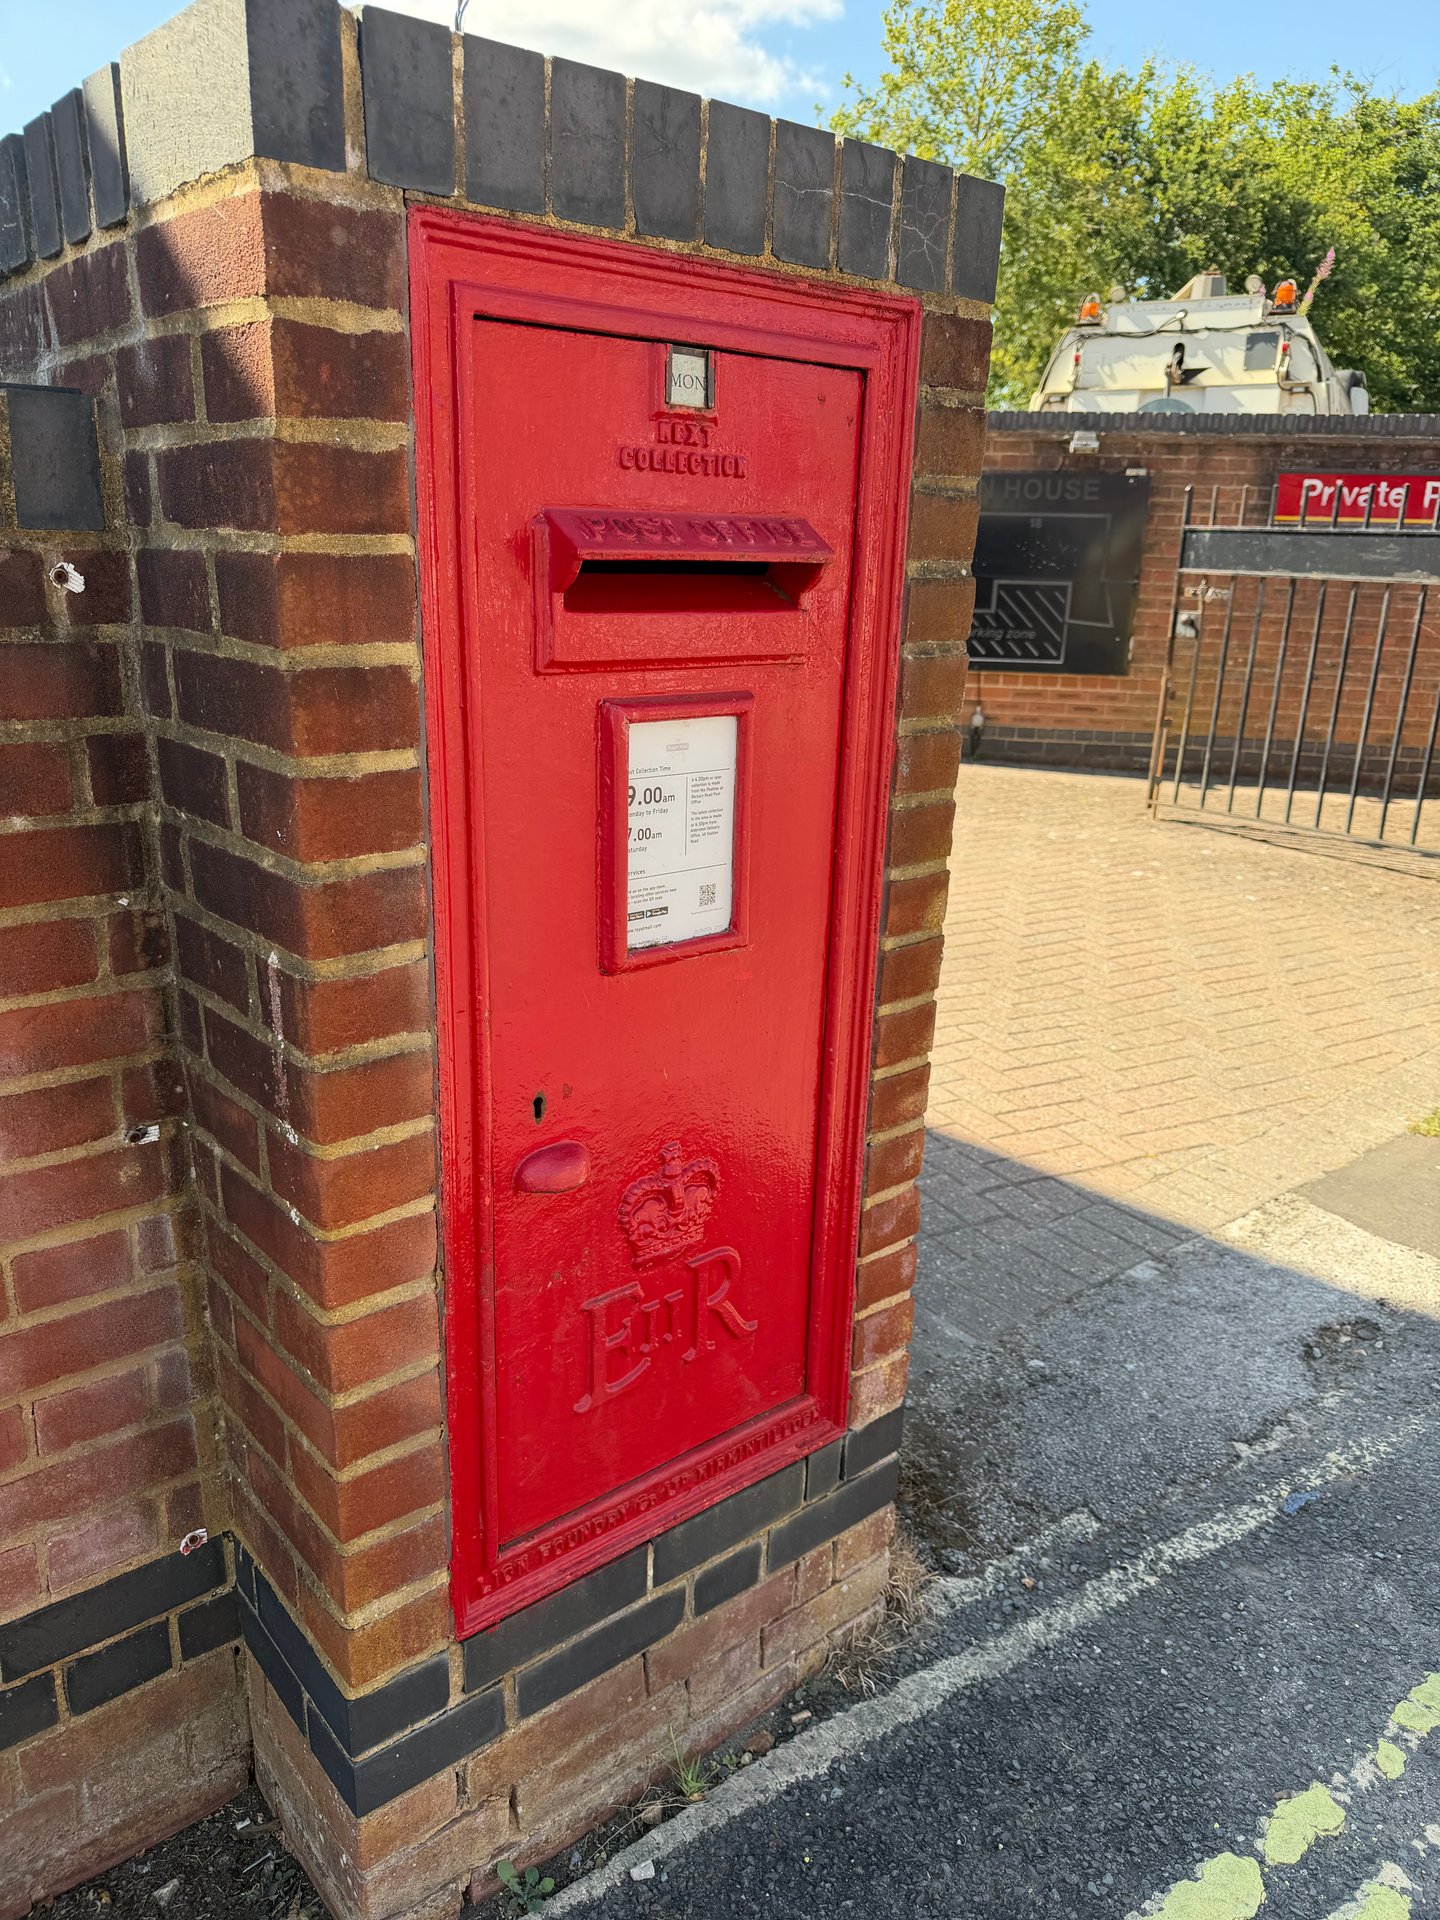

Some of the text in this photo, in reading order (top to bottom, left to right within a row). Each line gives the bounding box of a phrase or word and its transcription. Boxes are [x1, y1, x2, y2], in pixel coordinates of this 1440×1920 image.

[672, 373, 705, 391] MON
[657, 419, 714, 448] NEXT
[618, 446, 747, 478] COLLECTION
[1004, 479, 1101, 500] HOUSE
[1300, 478, 1405, 507] Prvate
[578, 517, 818, 547] POST OFFICE
[970, 628, 1037, 641] rking zone
[635, 766, 659, 775] Collection
[628, 785, 676, 806] 9.00am
[652, 807, 669, 815] Friday
[628, 846, 648, 854] aturday
